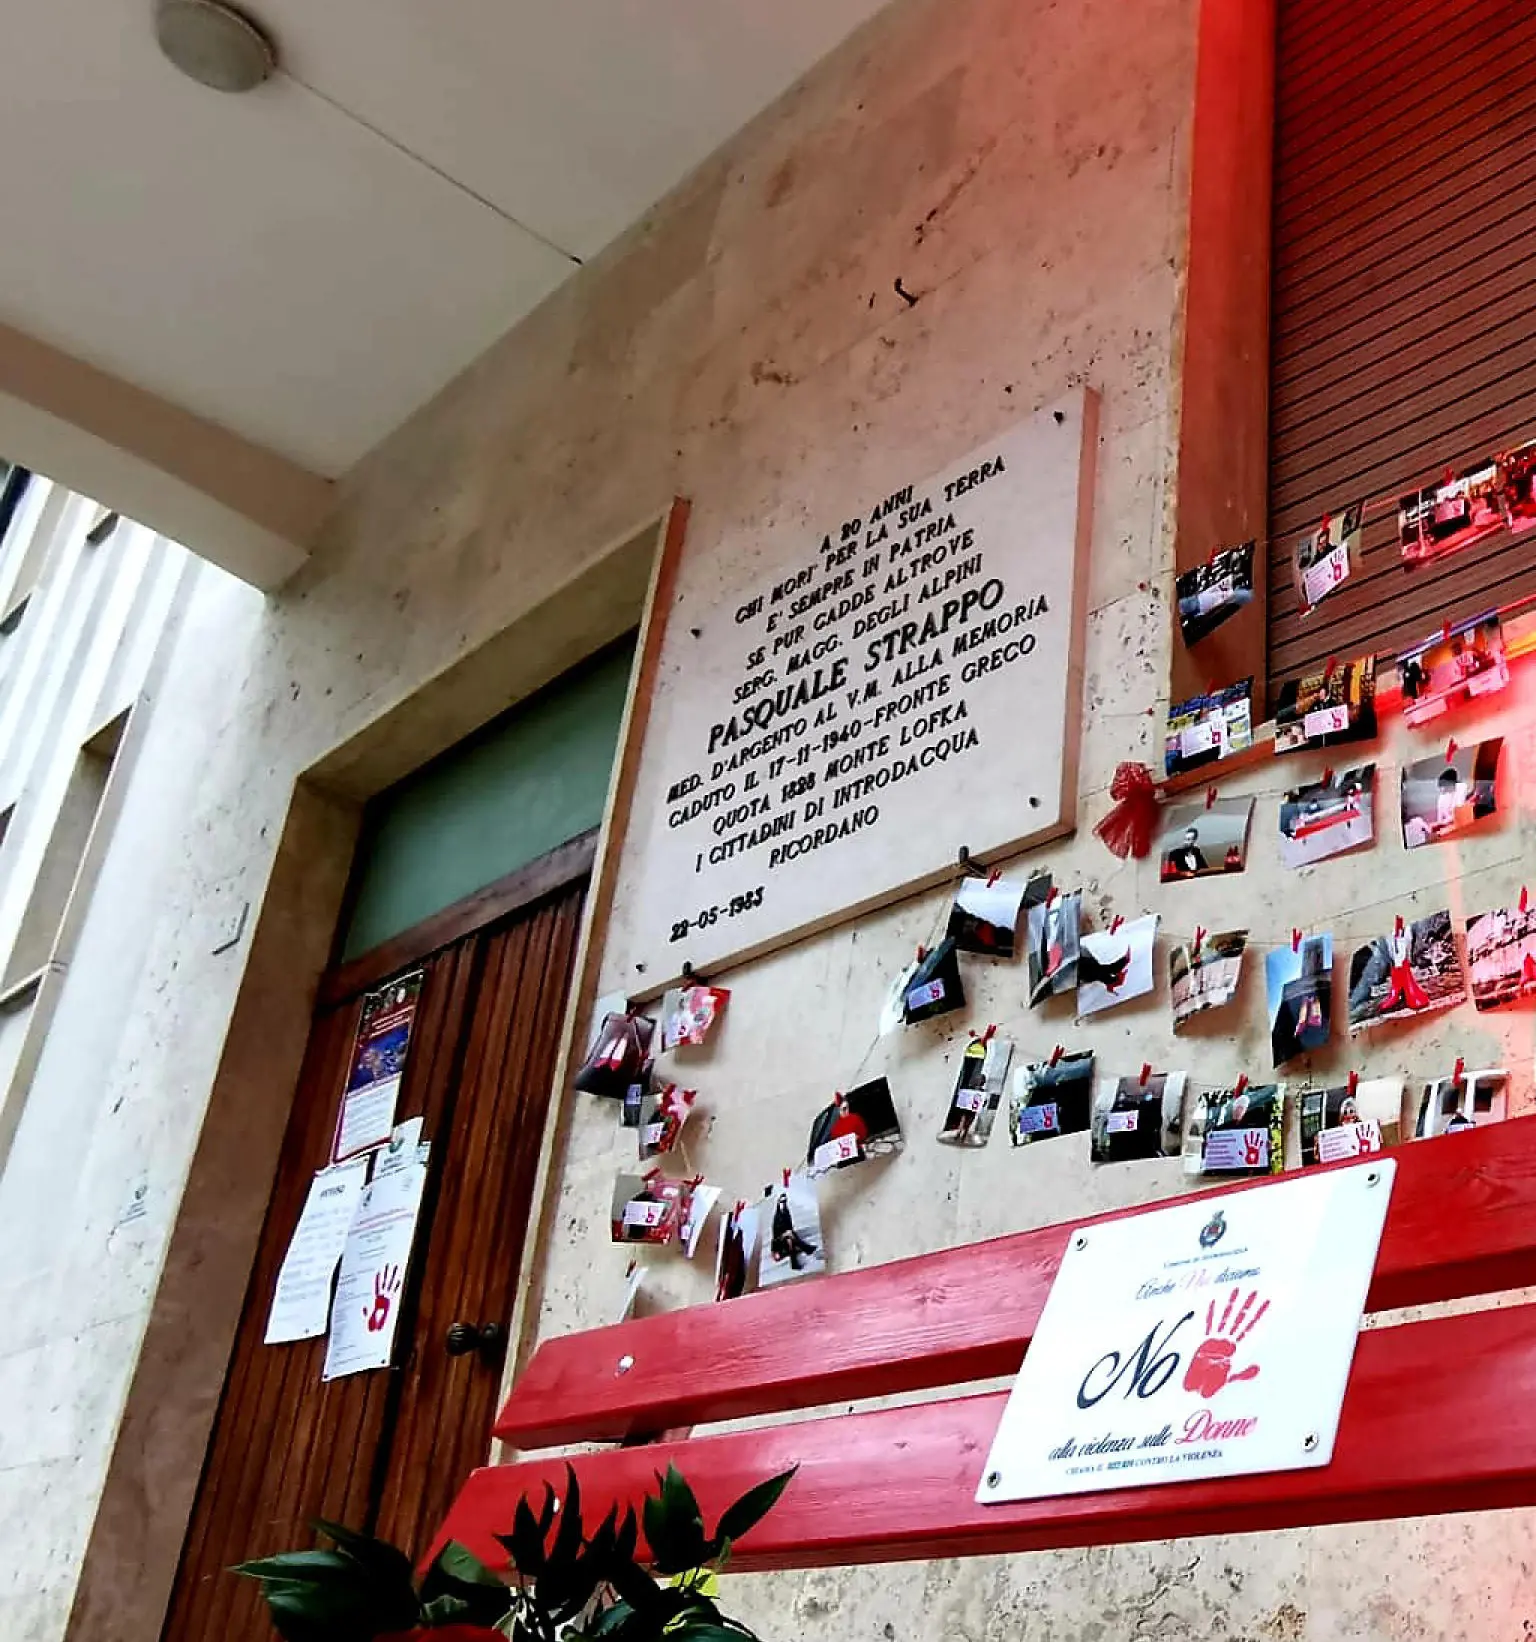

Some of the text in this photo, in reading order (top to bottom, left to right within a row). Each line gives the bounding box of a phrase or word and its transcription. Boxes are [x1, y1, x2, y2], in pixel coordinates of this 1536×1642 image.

[788, 568, 855, 619] SEMPRE
[862, 553, 880, 577] IN
[889, 512, 956, 563] PATRIA
[820, 485, 914, 553] A 20 ANNI
[825, 541, 857, 572] PER
[865, 524, 888, 548] LA
[897, 498, 932, 528] SUA
[944, 455, 1005, 501] TERRA
[746, 646, 766, 670] SE
[772, 624, 804, 655] PUR
[883, 528, 974, 593] ALTROVE
[851, 593, 910, 639] DEGLI
[918, 552, 983, 603] ALPINI
[707, 578, 1004, 754] PASQUALE STRAPPO
[813, 702, 837, 728] AL
[891, 647, 943, 688] ALLA
[951, 594, 1050, 657] MEMORIA
[668, 783, 735, 828] CADUTO
[743, 770, 760, 792] IL
[961, 633, 1036, 684] GRECO
[713, 792, 772, 836] QUOTA
[824, 734, 891, 782] MONTE
[899, 699, 968, 746] LOFKA
[695, 728, 979, 873] I CITTADINI DI INTRODACQUA
[768, 805, 880, 869] RICORDANO
[1077, 1311, 1195, 1409] No
[1077, 1432, 1136, 1457] violenza
[1174, 1409, 1258, 1445] Donne
